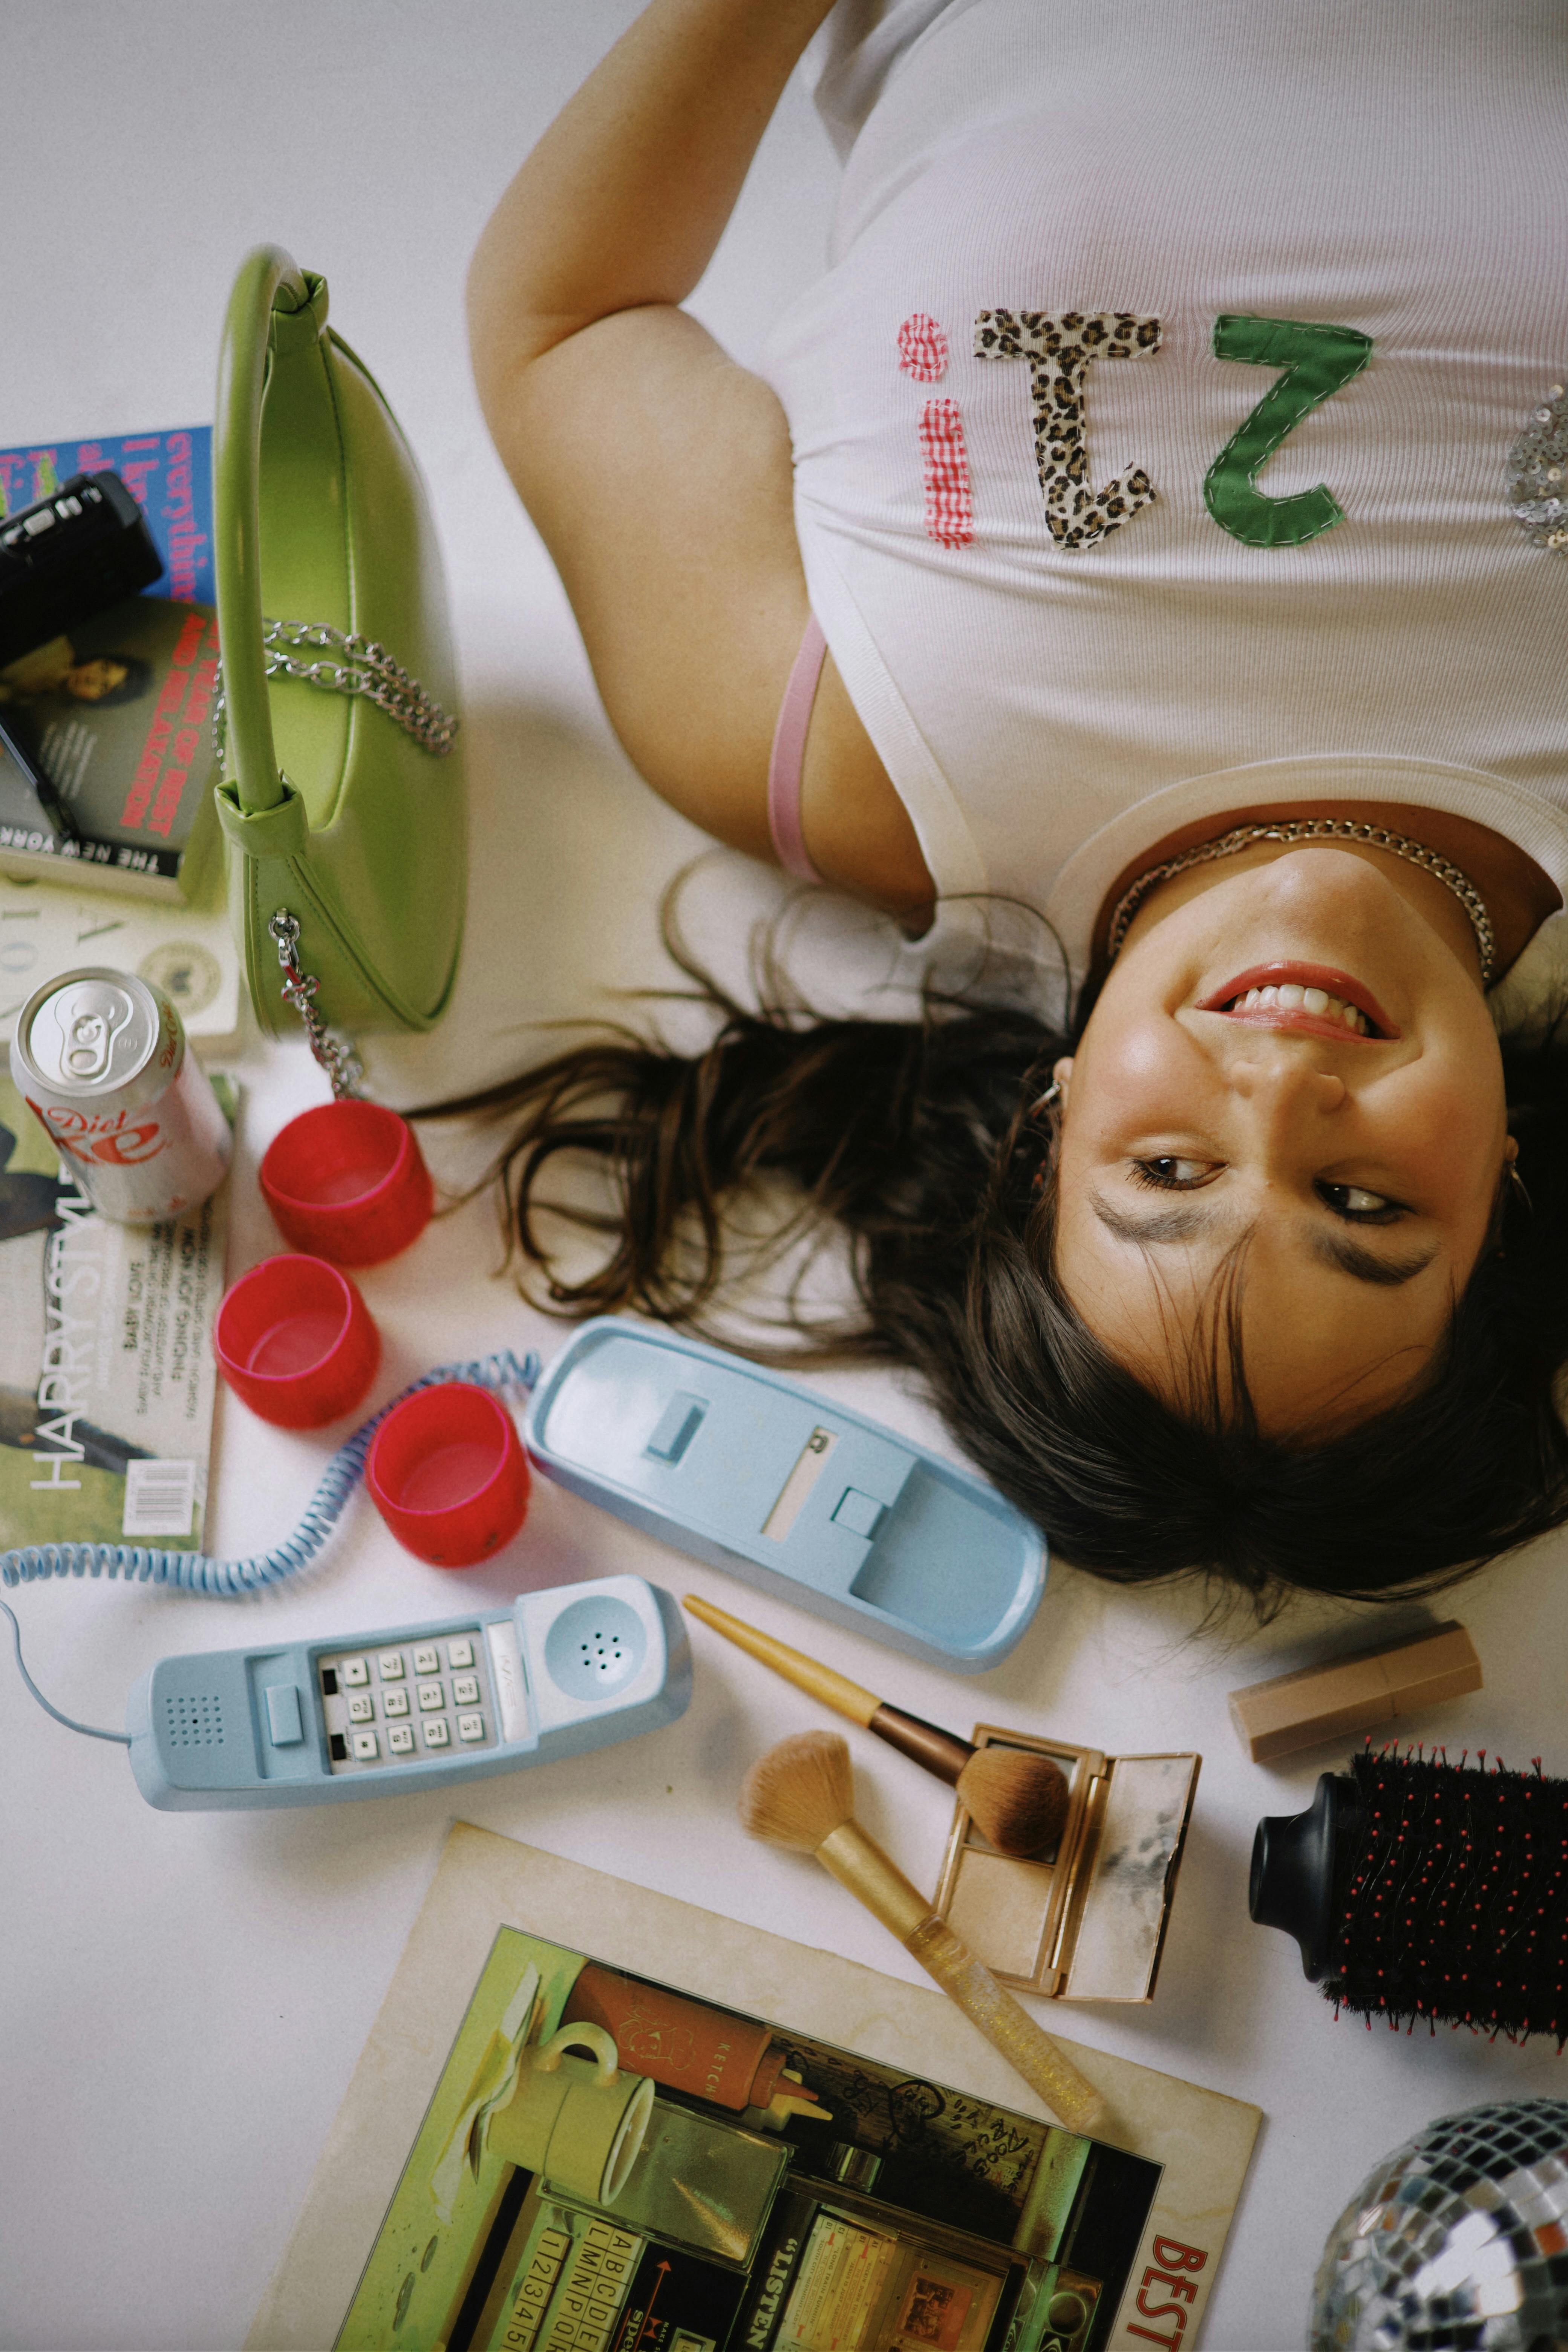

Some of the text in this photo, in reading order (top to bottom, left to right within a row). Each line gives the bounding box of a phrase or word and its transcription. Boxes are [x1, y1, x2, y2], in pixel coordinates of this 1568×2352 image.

[120, 612, 207, 828] AND RELAXATION
[173, 729, 199, 767] OF
[147, 768, 188, 838] REST
[0, 826, 159, 874] THE NEW YORK
[47, 1106, 127, 1133] Diet
[121, 1260, 144, 1352] BABY LOVE
[170, 1227, 198, 1382] FINDING JOY NOW
[31, 1309, 93, 1490] HARRY
[458, 1686, 467, 1694] 2
[463, 1722, 471, 1730] 3
[588, 2226, 609, 2237] L
[824, 2221, 833, 2230] D1
[837, 2226, 845, 2235] C1
[542, 2239, 560, 2248] 1
[613, 2236, 632, 2250] A
[858, 2234, 866, 2243] B1
[870, 2239, 879, 2249] A1
[579, 2248, 601, 2267] M
[532, 2260, 551, 2274] 2
[605, 2259, 625, 2274] B
[809, 2262, 817, 2275] CITY
[571, 2272, 592, 2291] N
[819, 2272, 831, 2294] TRAIN
[524, 2283, 543, 2298] 3
[597, 2284, 616, 2298] C
[797, 2276, 812, 2308] MIDNIGHT
[838, 2287, 846, 2302] JUST
[854, 2285, 865, 2302] DOWN
[1126, 2235, 1208, 2352] BEST
[566, 2297, 583, 2312] P
[516, 2307, 533, 2322] 4
[589, 2306, 608, 2321] D
[554, 2321, 574, 2335] Q
[658, 2321, 669, 2343] MAKE
[507, 2330, 526, 2345] 5
[579, 2330, 600, 2345] E
